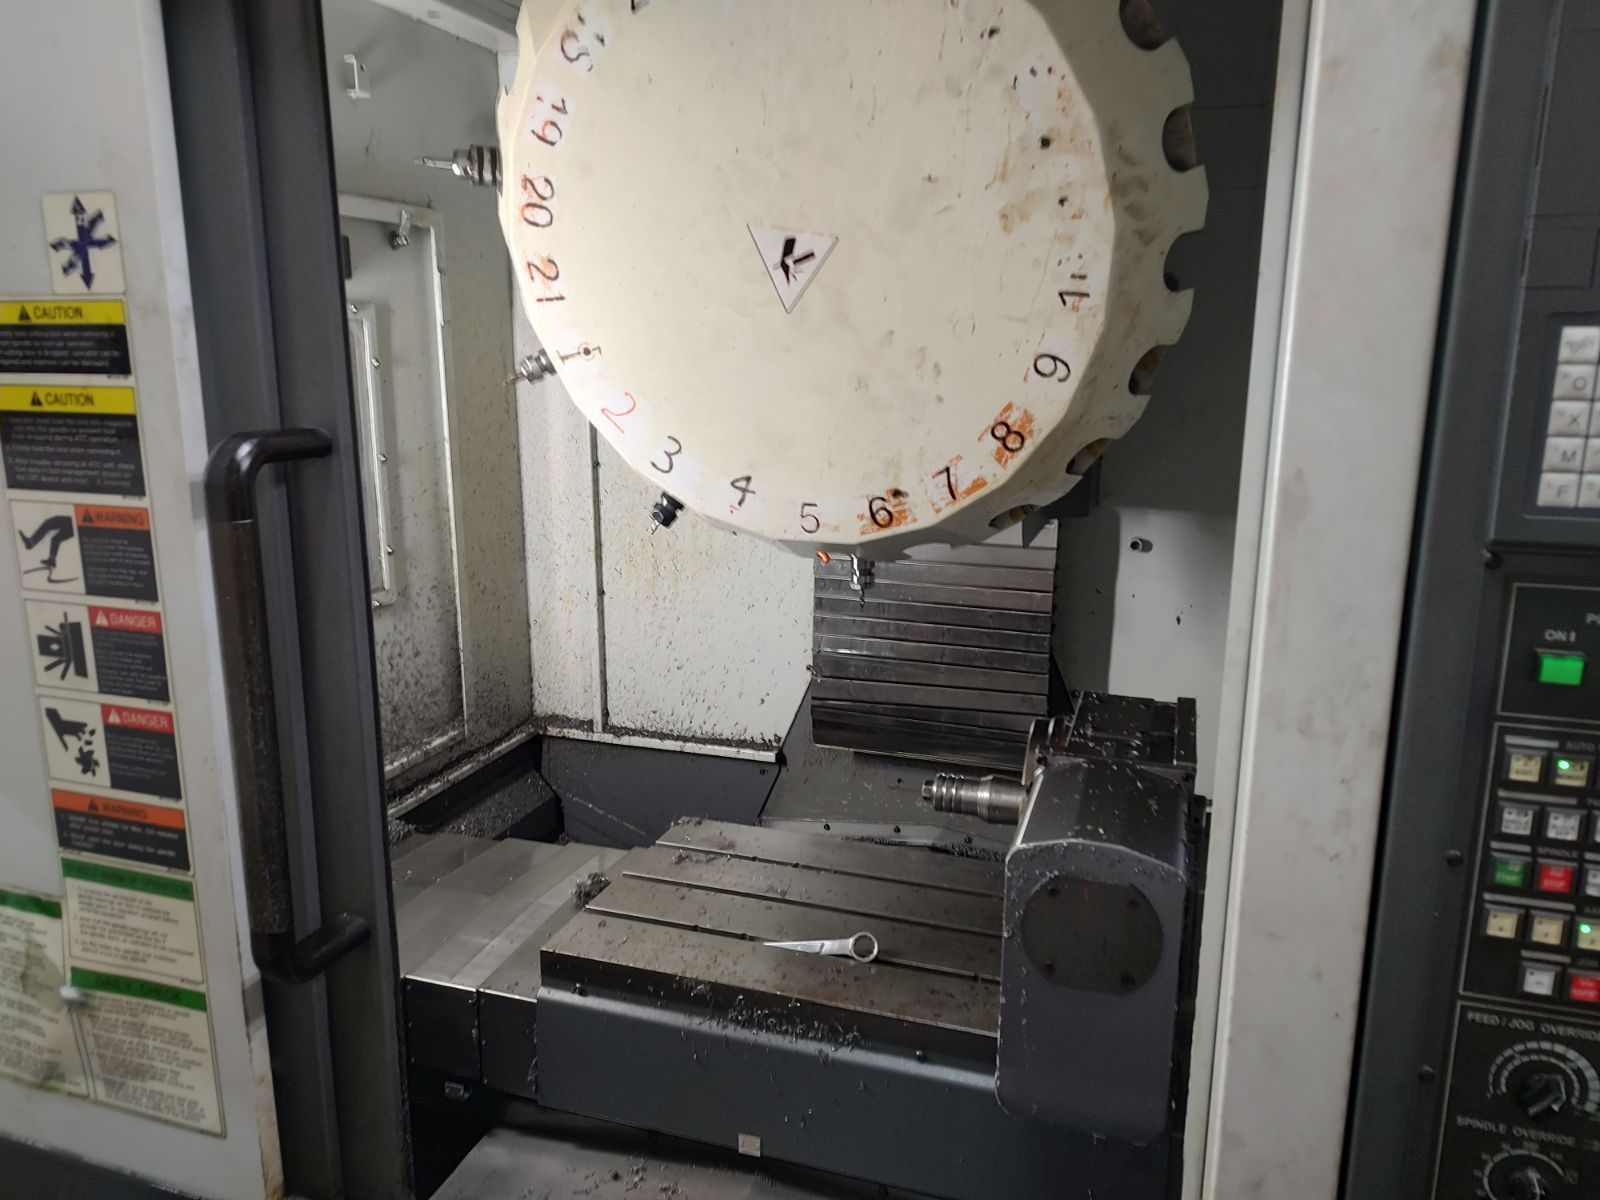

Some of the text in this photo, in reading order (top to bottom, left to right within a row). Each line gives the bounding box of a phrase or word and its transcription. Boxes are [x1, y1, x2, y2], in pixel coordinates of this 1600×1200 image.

[531, 98, 569, 146] 19
[521, 174, 555, 228] 20
[527, 258, 566, 303] 21
[33, 306, 83, 320] CAUTION
[1033, 353, 1071, 383] 9
[45, 393, 95, 406] CAUTION
[601, 392, 636, 434] 2
[990, 420, 1025, 453] 8
[651, 436, 682, 474] 3
[1562, 451, 1576, 463] M
[730, 475, 756, 508] 4
[932, 466, 957, 501] 7
[800, 503, 820, 534] 5
[868, 496, 894, 529] 6
[109, 612, 157, 628] DANGER
[122, 711, 169, 728] DANGER
[1456, 1115, 1507, 1134] SPINDLE
